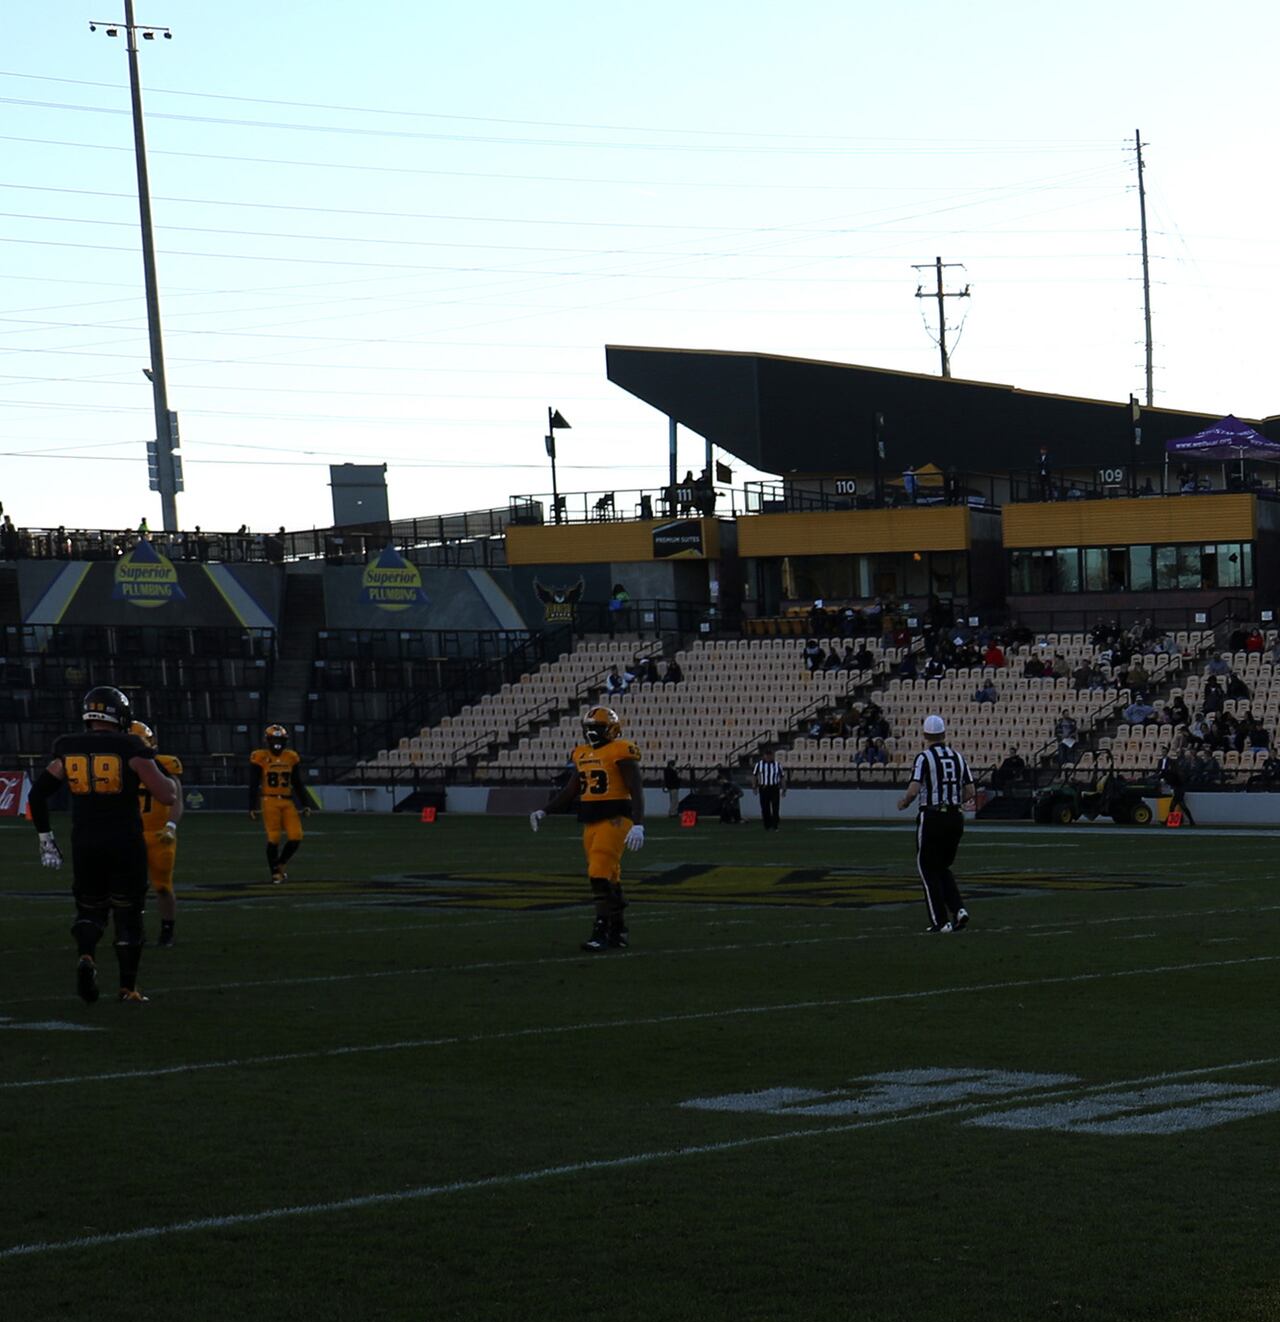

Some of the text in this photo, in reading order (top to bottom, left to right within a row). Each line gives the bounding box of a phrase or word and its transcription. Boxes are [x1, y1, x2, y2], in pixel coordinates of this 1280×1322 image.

[1099, 469, 1123, 483] 109
[677, 488, 692, 501] 111
[836, 481, 855, 494] 110
[655, 536, 680, 544] PREMIUM
[119, 564, 172, 581] Superior
[366, 570, 419, 584] Superior
[121, 582, 172, 599] PLUMBING
[368, 587, 417, 601] PLUMBING
[65, 755, 123, 796] 99
